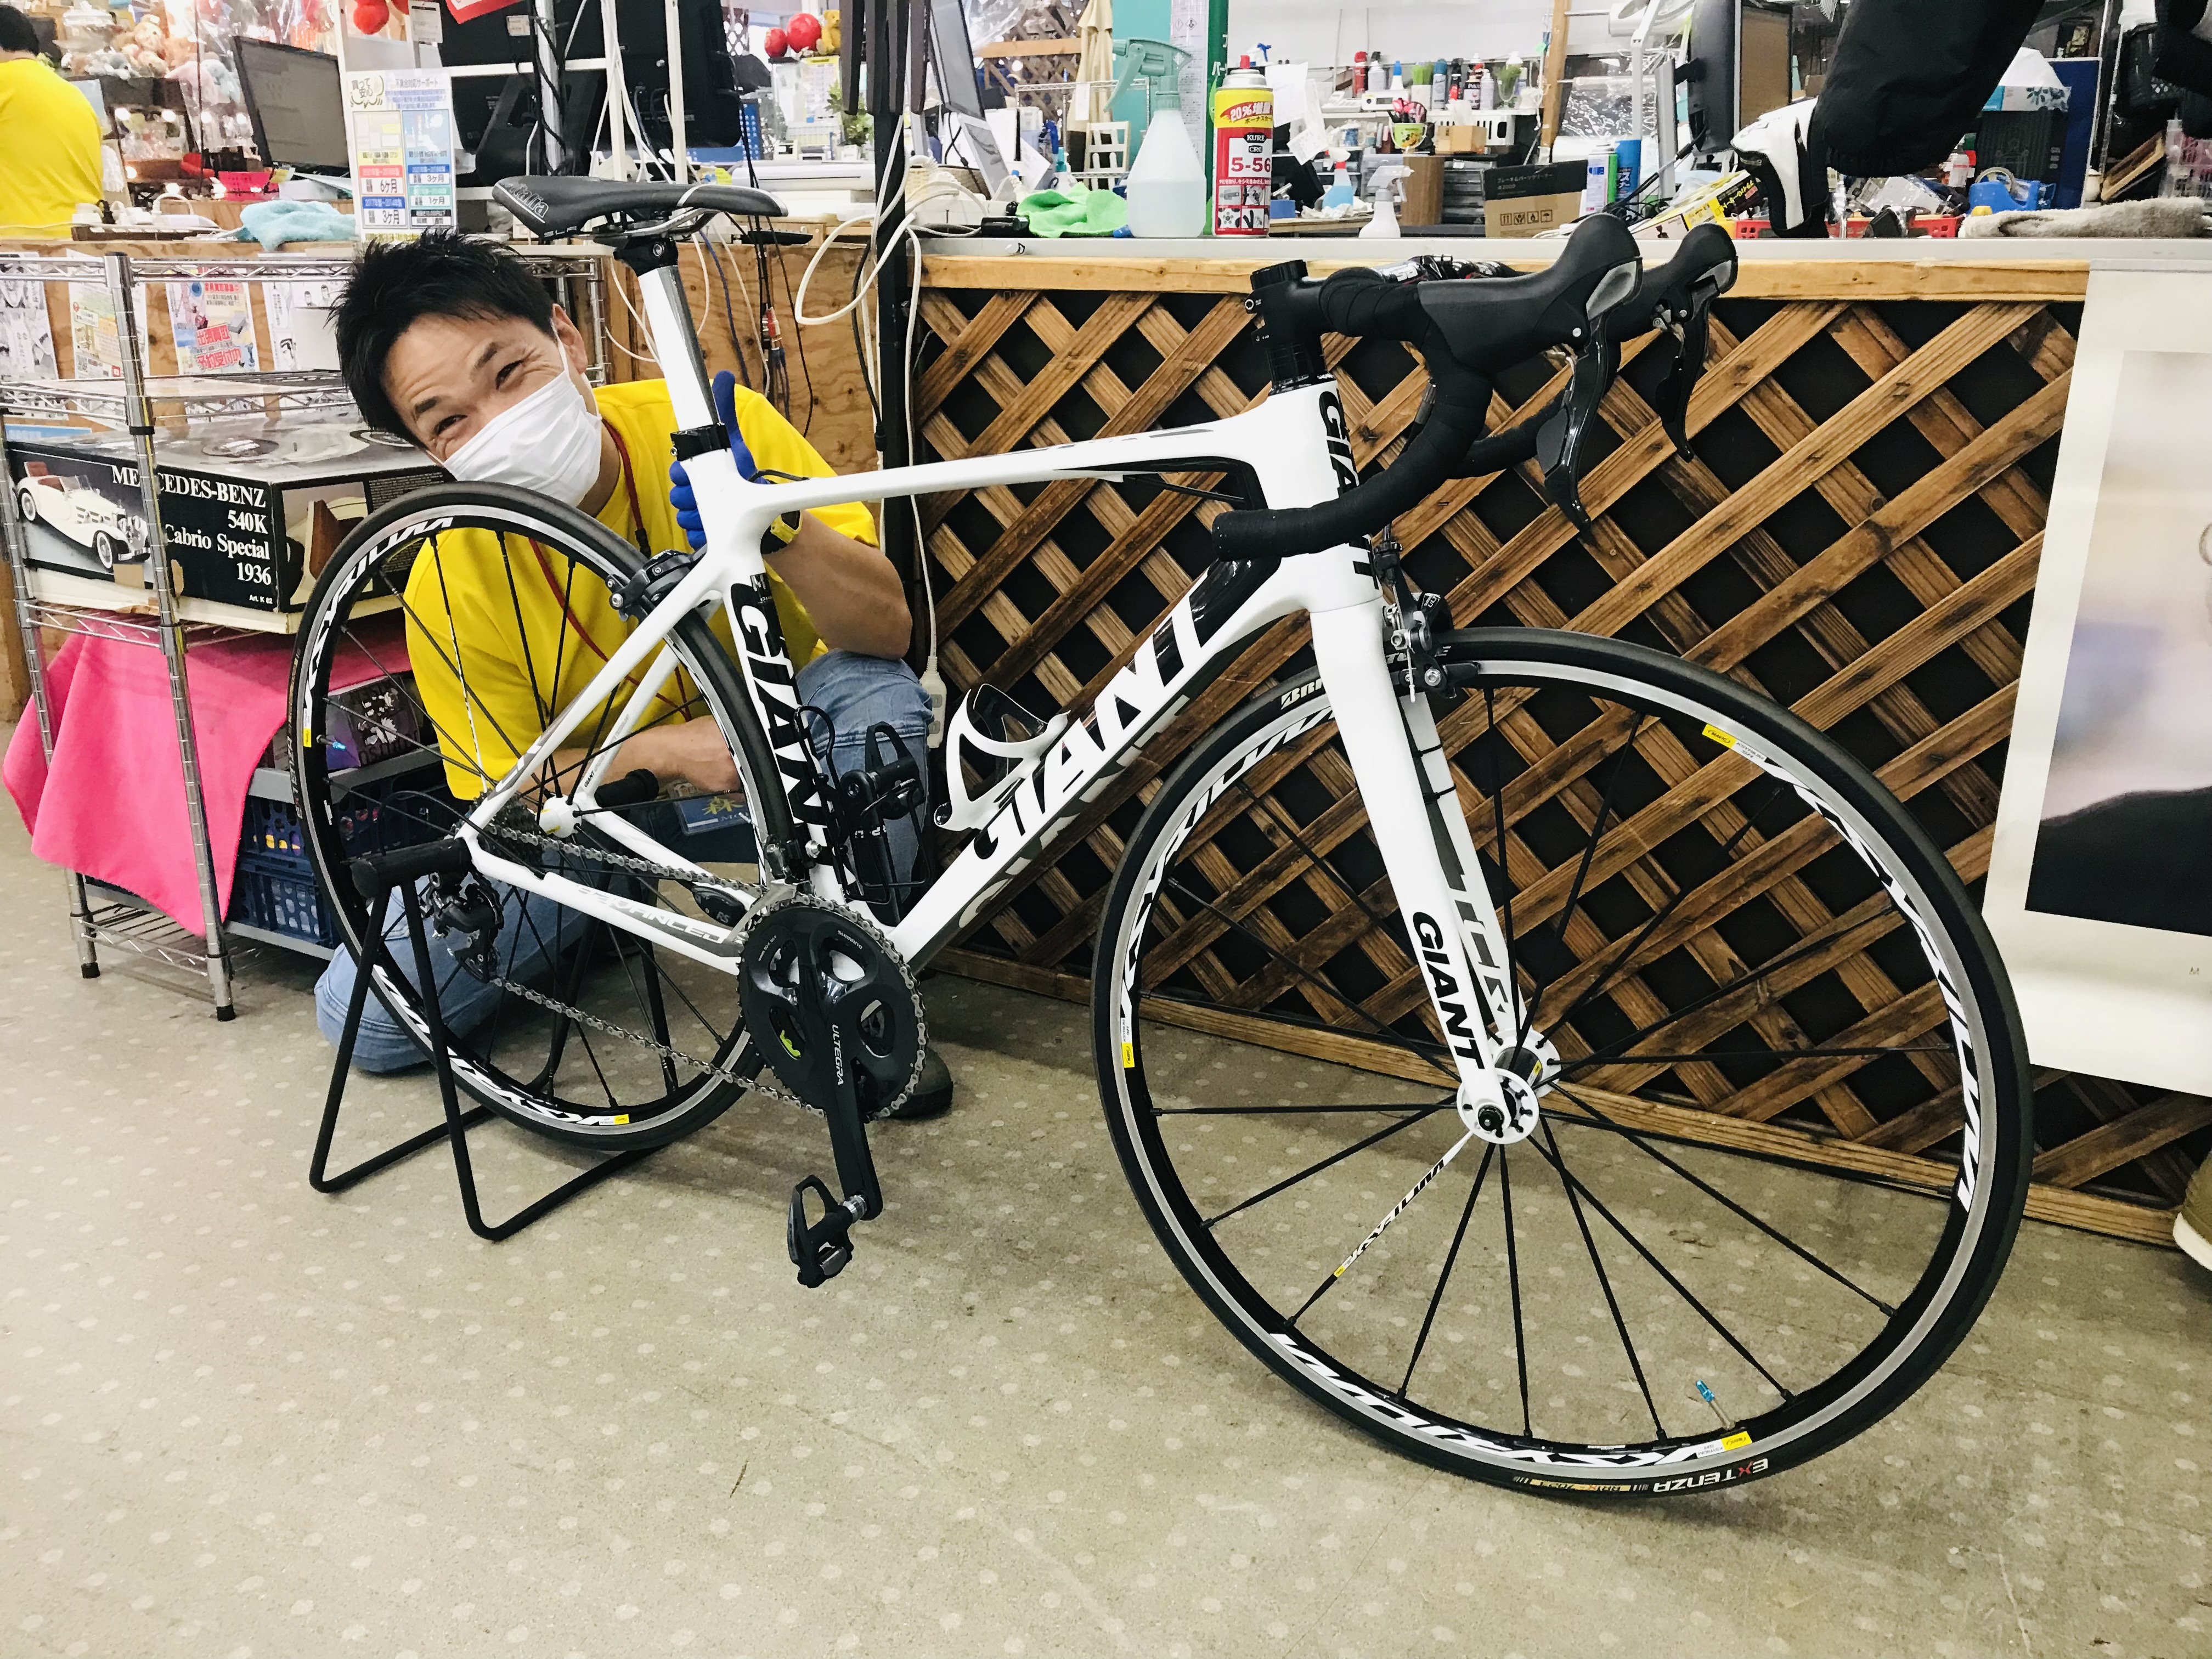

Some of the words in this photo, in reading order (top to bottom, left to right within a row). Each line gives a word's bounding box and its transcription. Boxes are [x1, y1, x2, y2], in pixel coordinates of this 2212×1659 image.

[1231, 157, 1271, 173] 5-56
[228, 509, 268, 534] 540K
[165, 523, 212, 549] Cabrio
[217, 533, 270, 560] Special
[236, 562, 272, 585] 1936
[583, 771, 595, 788] GIANT
[838, 930, 863, 950] SHIMANO
[1413, 911, 1486, 1070] GIANT
[832, 1024, 844, 1085] ULTEGRA
[1653, 1458, 1768, 1492] EXTENZA
